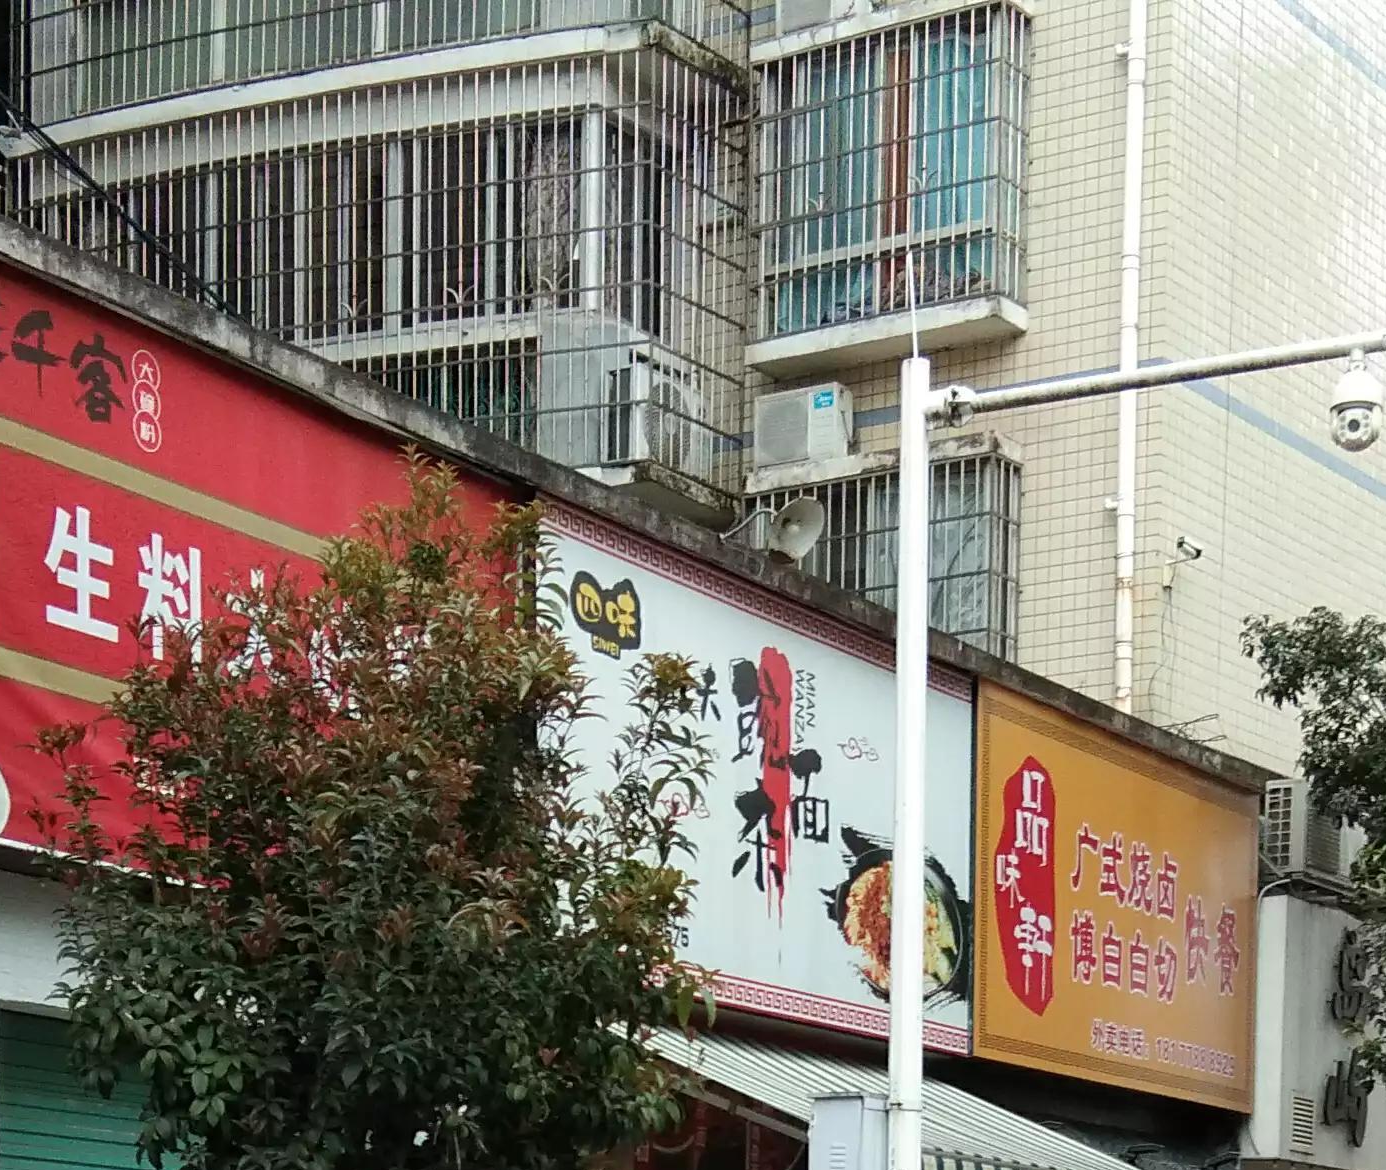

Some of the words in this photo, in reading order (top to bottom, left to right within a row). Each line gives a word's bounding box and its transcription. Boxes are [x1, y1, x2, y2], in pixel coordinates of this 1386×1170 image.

[805, 672, 816, 728] MIAN
[995, 768, 1054, 1002] 品味轩
[1071, 823, 1179, 921] 广式烧卤
[1183, 894, 1241, 997] 快餐
